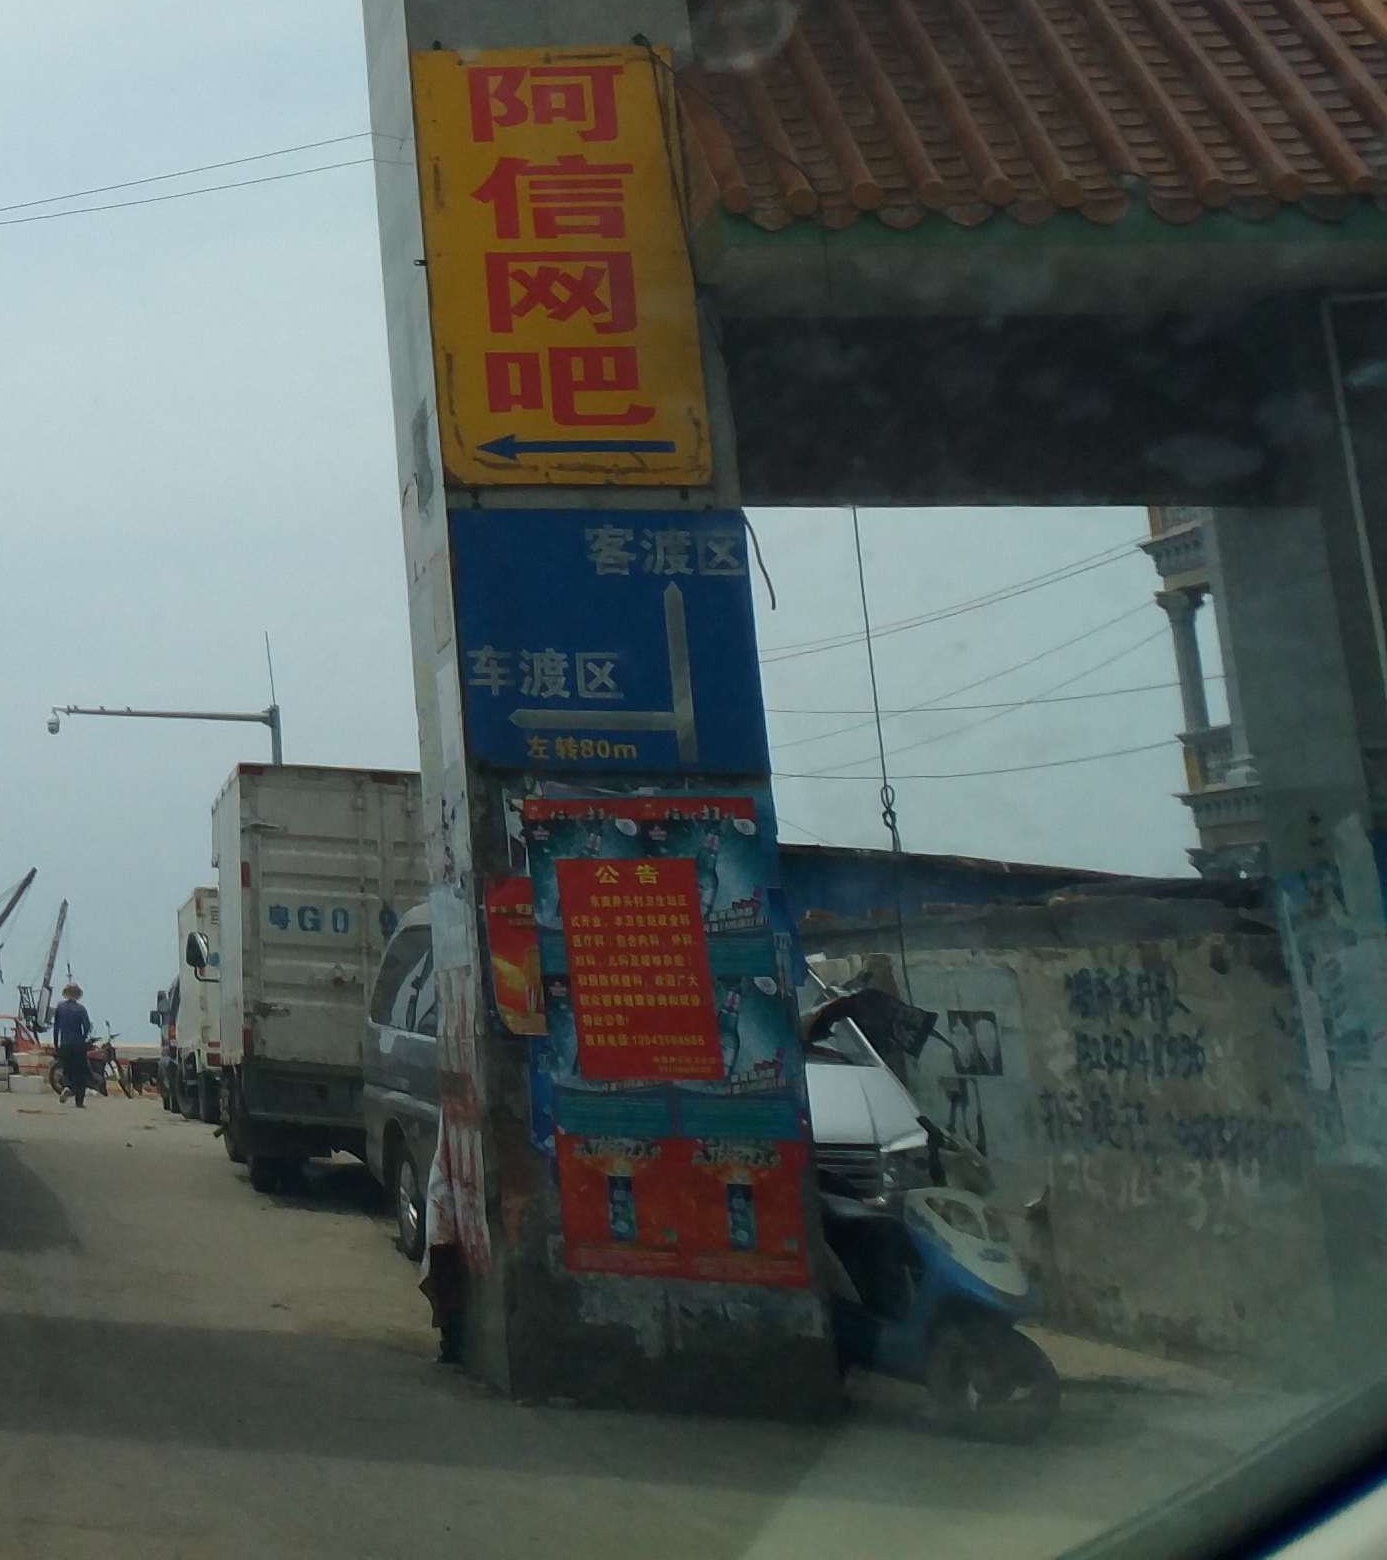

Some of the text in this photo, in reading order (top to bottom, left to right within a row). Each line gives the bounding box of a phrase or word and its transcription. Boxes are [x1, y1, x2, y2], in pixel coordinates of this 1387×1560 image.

[466, 64, 657, 427] 阿信网吧
[584, 523, 748, 577] 客渡区
[466, 644, 625, 700] 车渡区
[527, 735, 638, 761] 左转80m
[593, 864, 660, 885] 公告
